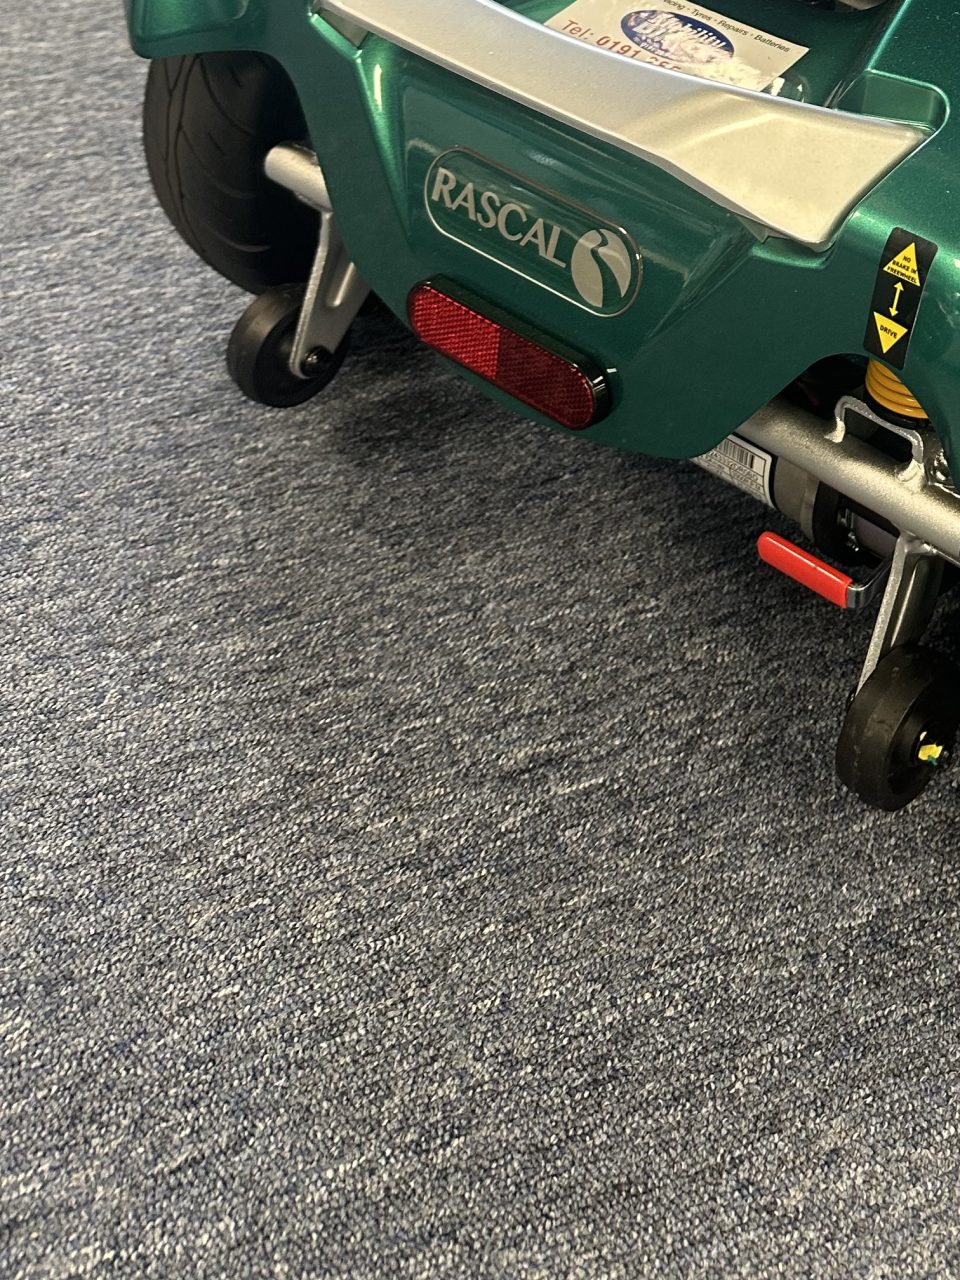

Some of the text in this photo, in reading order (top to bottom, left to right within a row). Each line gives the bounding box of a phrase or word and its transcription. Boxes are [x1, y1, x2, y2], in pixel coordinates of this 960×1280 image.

[562, 20, 594, 40] Tel:
[596, 35, 642, 59] 0191
[691, 8, 713, 22] Tyres
[717, 19, 750, 37] Repairs
[753, 33, 791, 53] Batteries
[431, 167, 567, 268] RASCAL
[892, 260, 911, 271] BRAKE
[903, 255, 911, 263] NO
[887, 266, 917, 284] FREEWHEEL
[879, 324, 898, 339] DRIVE
